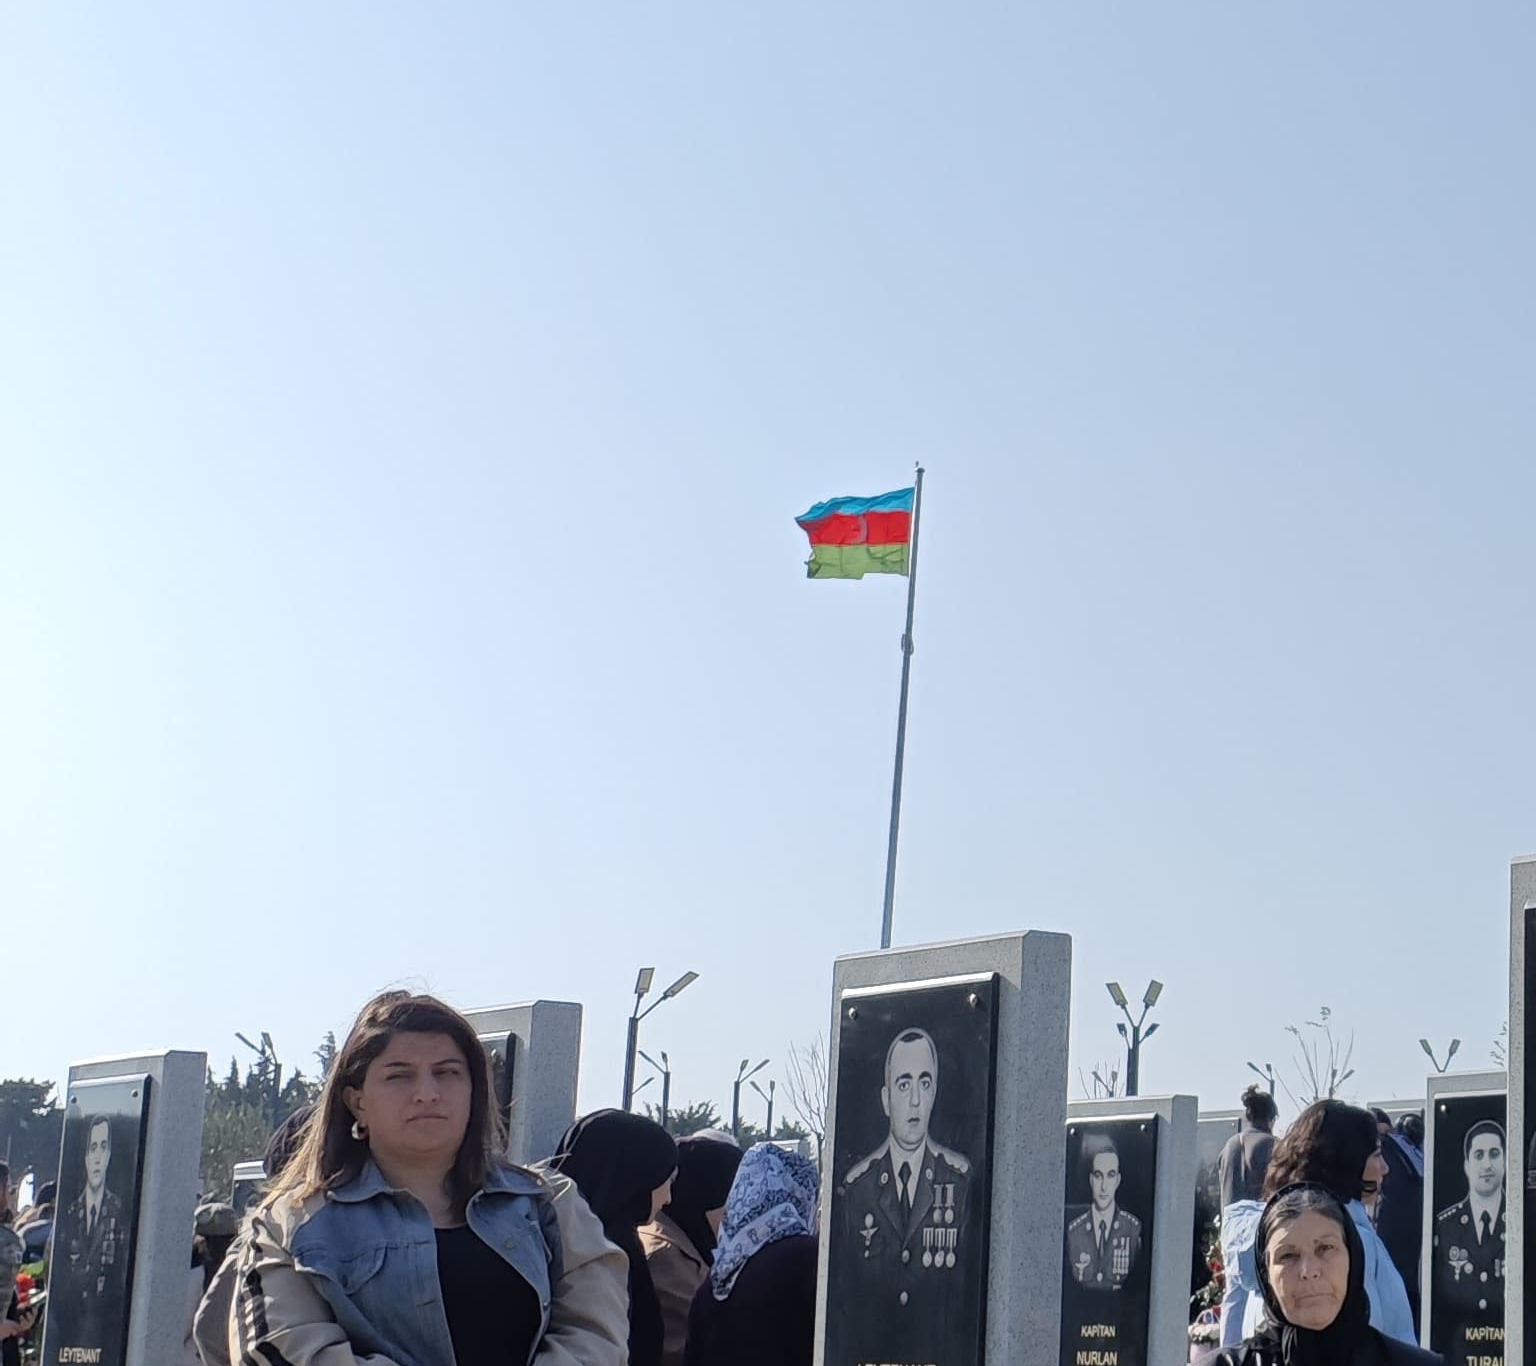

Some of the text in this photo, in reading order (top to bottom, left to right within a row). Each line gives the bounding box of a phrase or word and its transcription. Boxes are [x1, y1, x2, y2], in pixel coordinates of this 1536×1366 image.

[1081, 1324, 1116, 1337] KAPİTAN
[59, 1347, 102, 1363] LEYTENANT
[1076, 1351, 1118, 1366] NURLAN
